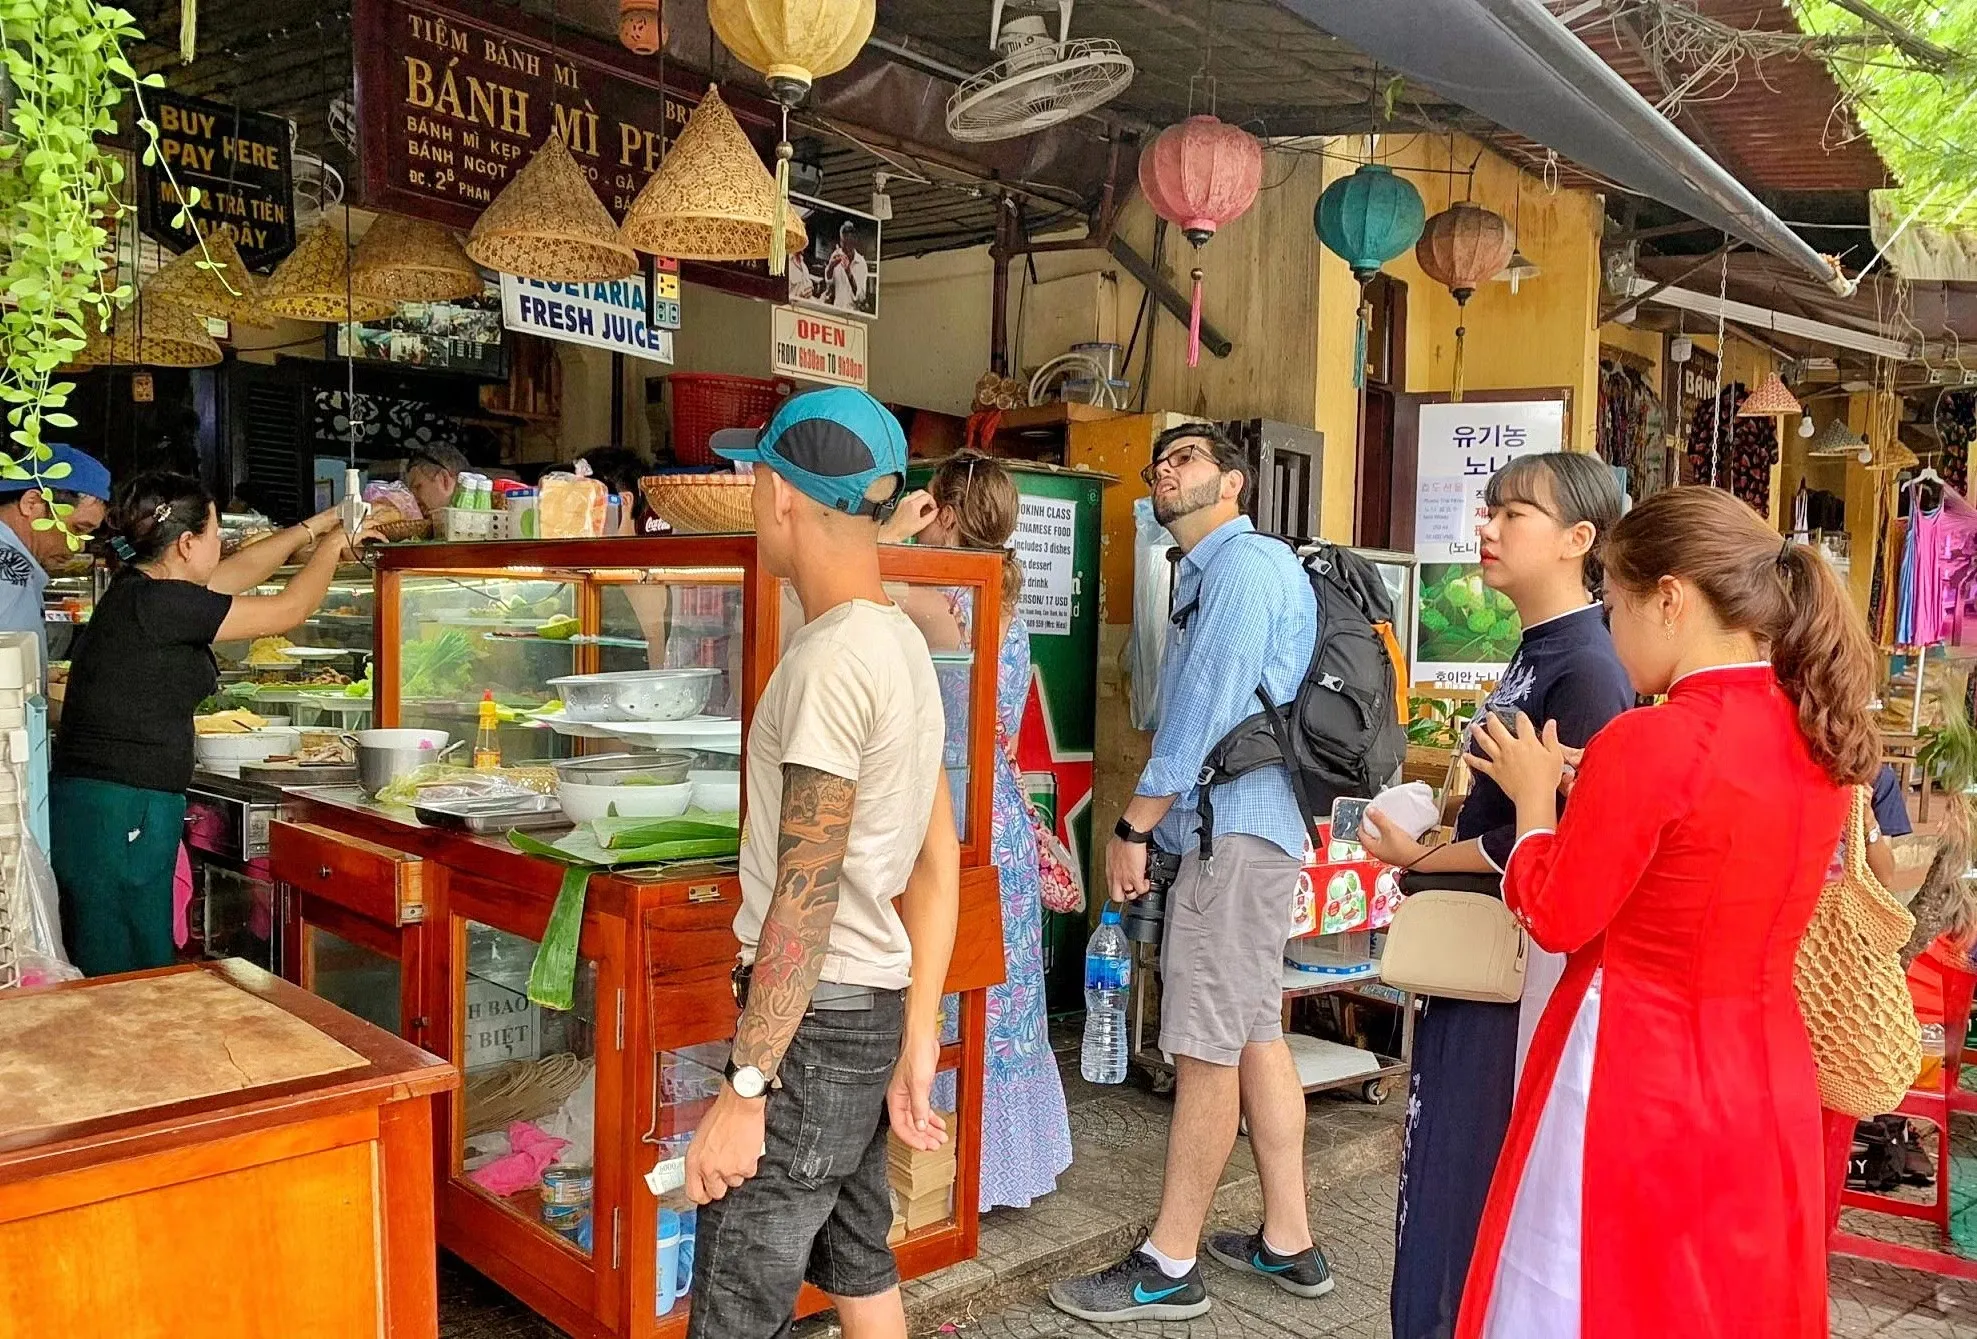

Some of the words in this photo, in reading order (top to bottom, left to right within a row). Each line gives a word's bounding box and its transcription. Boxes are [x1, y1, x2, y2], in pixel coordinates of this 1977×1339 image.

[408, 14, 469, 54] TIỆM
[484, 38, 540, 77] BÁNH
[553, 62, 580, 89] MÌ
[160, 105, 215, 139] BUY
[404, 56, 532, 138] BÁNH
[551, 99, 600, 157] MÌ
[618, 121, 680, 173] PH
[162, 138, 215, 171] PAY
[222, 135, 279, 170] HERE
[407, 115, 453, 142] BÁNH
[463, 130, 480, 149] MÌ
[490, 139, 522, 165] KẸP
[616, 174, 635, 192] GÀ
[408, 139, 454, 166] BÁNH
[464, 154, 508, 181] NGỌT
[200, 189, 212, 210] &
[215, 188, 246, 216] TRẢ
[458, 181, 491, 203] PHAN
[519, 294, 594, 336] FRESH
[602, 312, 660, 350] JUICE
[797, 319, 845, 347] OPEN
[777, 342, 797, 366] FROM
[827, 353, 836, 374] TO
[1453, 424, 1527, 448] 유기농
[1046, 506, 1071, 520] CLASS
[1054, 526, 1071, 537] FOOD
[1014, 540, 1042, 553] Includes
[1044, 542, 1049, 553] 3
[1050, 542, 1071, 555] dishes
[1028, 559, 1052, 571] dessert
[1046, 596, 1053, 606] 17
[1055, 596, 1068, 606] USD
[1435, 671, 1471, 683] 호이안
